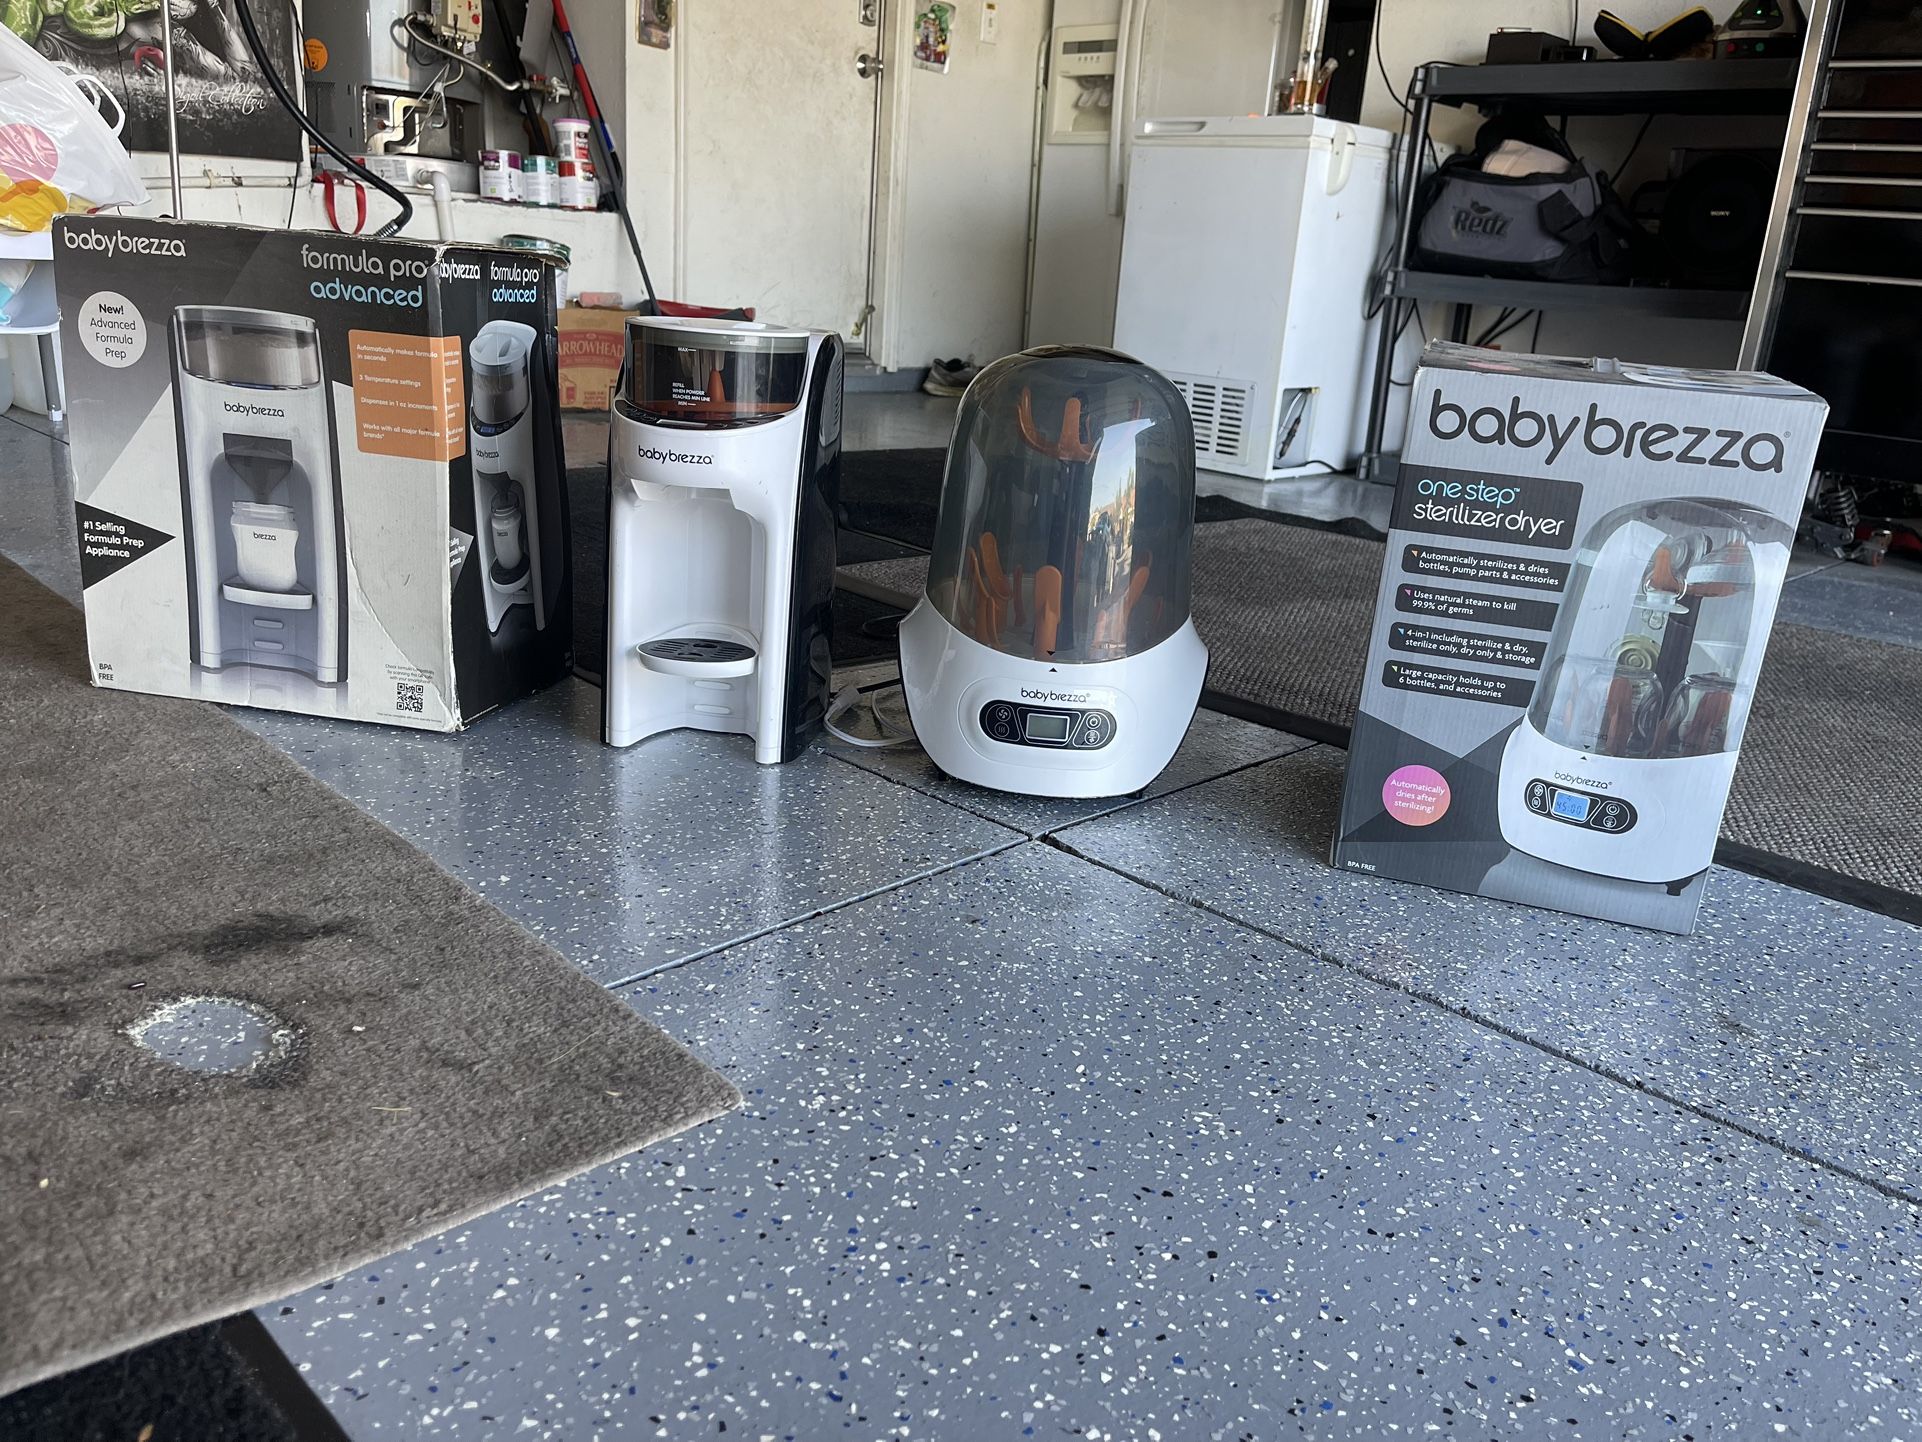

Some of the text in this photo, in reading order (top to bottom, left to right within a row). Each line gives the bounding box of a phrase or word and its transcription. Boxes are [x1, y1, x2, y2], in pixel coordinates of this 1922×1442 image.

[208, 82, 267, 115] Collection
[301, 243, 428, 282] formula pro
[490, 260, 540, 286] formula pro
[310, 277, 423, 308] advanced
[491, 284, 537, 303] advanced
[99, 303, 124, 315] New!
[90, 317, 136, 331] Advanced
[95, 332, 133, 345] Formula
[105, 347, 127, 360] Prep
[356, 344, 395, 355] Automatically
[396, 348, 414, 357] makes
[415, 350, 438, 358] formula
[364, 354, 387, 362] seconds
[364, 374, 399, 385] Temperature
[399, 379, 421, 388] settings
[360, 397, 388, 407] Dispenses
[407, 401, 438, 411] increments
[362, 422, 380, 431] Works
[380, 424, 393, 432] with
[401, 427, 417, 436] major
[418, 428, 440, 438] formula
[1417, 479, 1462, 498] one
[1413, 499, 1564, 539] sterilizer dryer
[83, 521, 126, 535] #1 Selling
[252, 531, 277, 541] brezza
[84, 533, 145, 549] Formula Prep
[85, 545, 130, 558] Appliance
[1420, 551, 1550, 574] Automatically sterilizes & dries
[1419, 560, 1559, 586] bottles, pump parts & accessories
[1412, 599, 1474, 615] 99.9% of germs
[1414, 590, 1517, 610] Uses natural steam to kill
[1406, 629, 1529, 654] 4-in-1 including sterilize & dry,
[1405, 639, 1437, 650] sterilize
[1439, 644, 1459, 654] only,
[1460, 647, 1475, 657] dry
[1476, 649, 1495, 659] only
[1504, 653, 1536, 665] storage
[99, 663, 113, 671] BPA
[98, 673, 114, 681] FREE
[1400, 667, 1506, 690] Large capacity holds up to
[1399, 676, 1502, 698] 6 bottles, and accessories
[1390, 779, 1445, 796] Automatically
[1395, 789, 1437, 803] dries after
[1394, 800, 1435, 814] sterilizing!
[1347, 860, 1377, 872] BPA FREE
